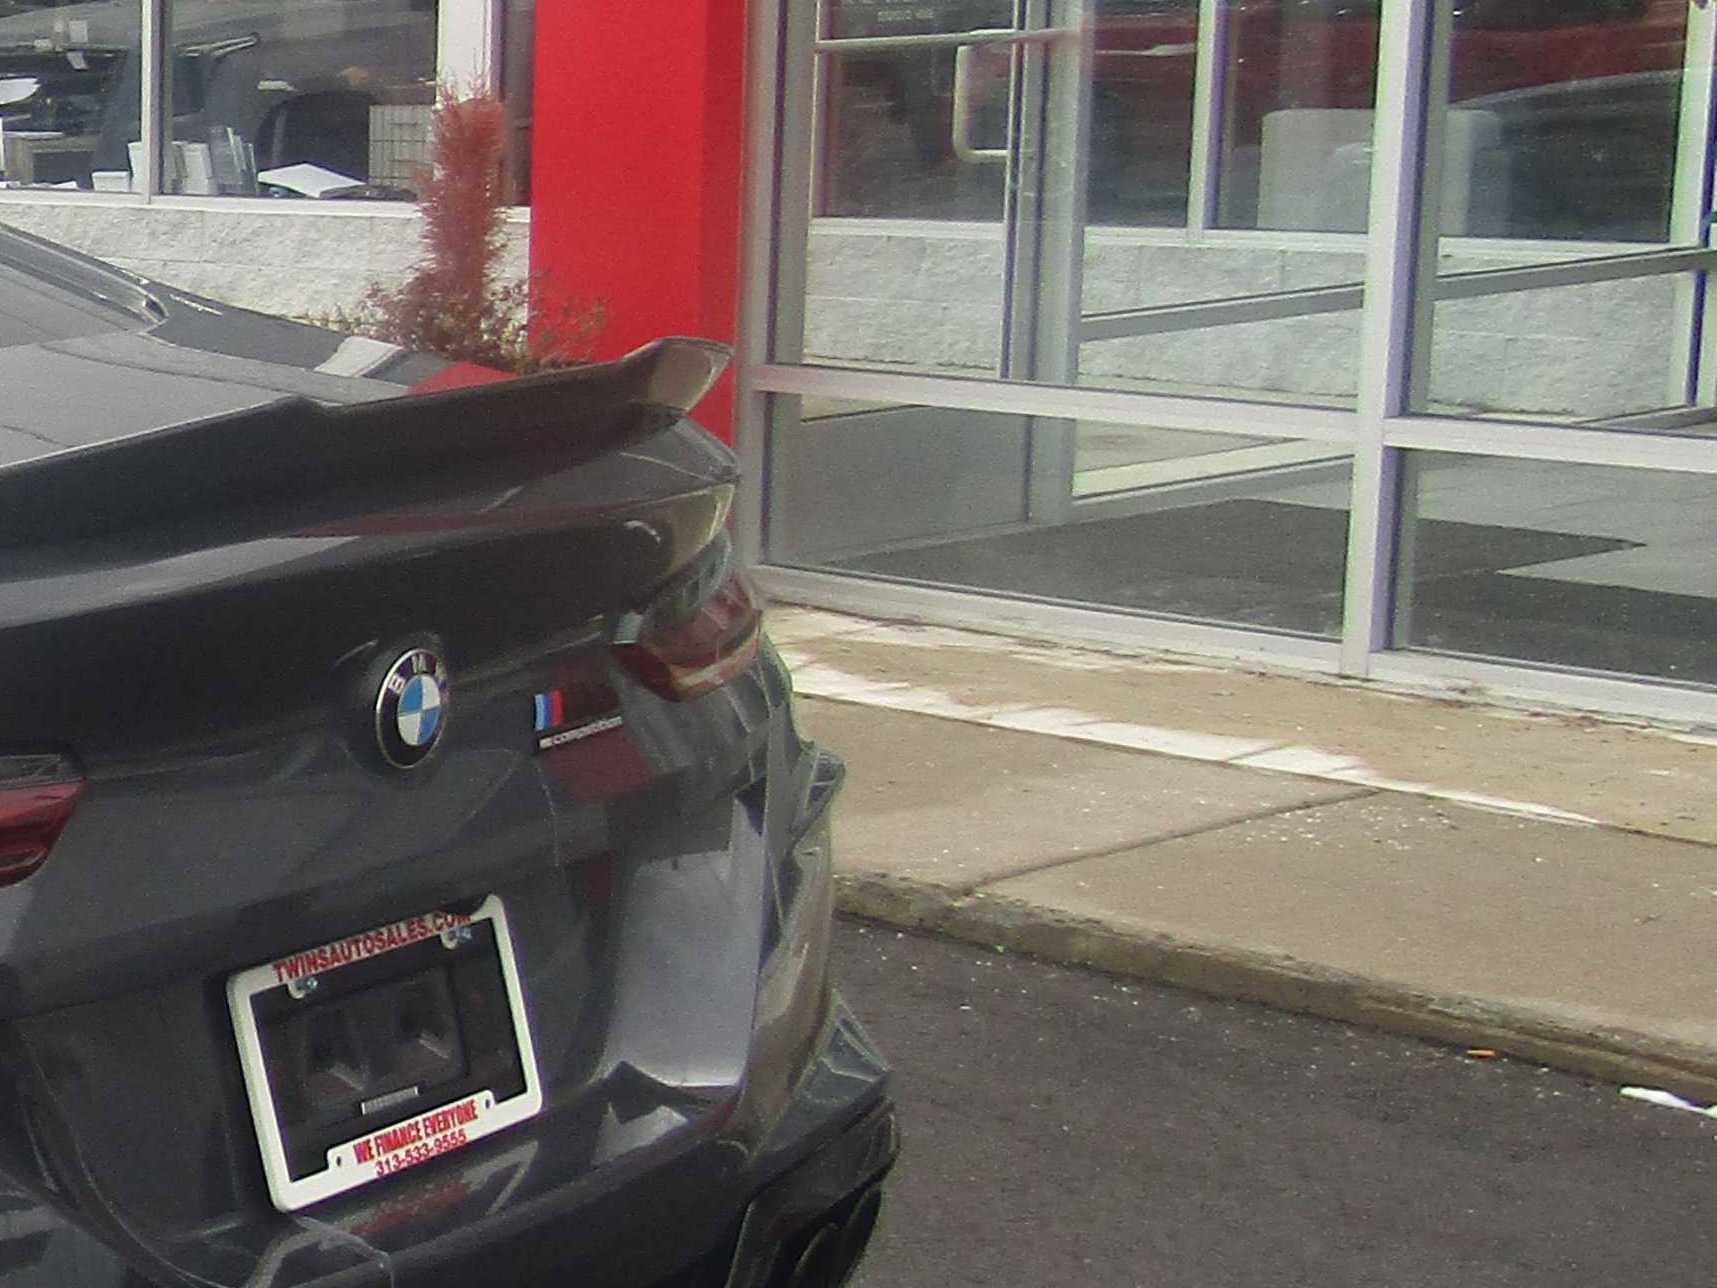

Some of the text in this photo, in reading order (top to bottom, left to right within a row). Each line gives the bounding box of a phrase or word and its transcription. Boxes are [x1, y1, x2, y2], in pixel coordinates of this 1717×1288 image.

[273, 911, 471, 983] TWINSAUTOSALES.COM
[353, 1098, 479, 1163] WE FINANCE EVERYONE
[374, 1128, 468, 1177] 313-533-9555
